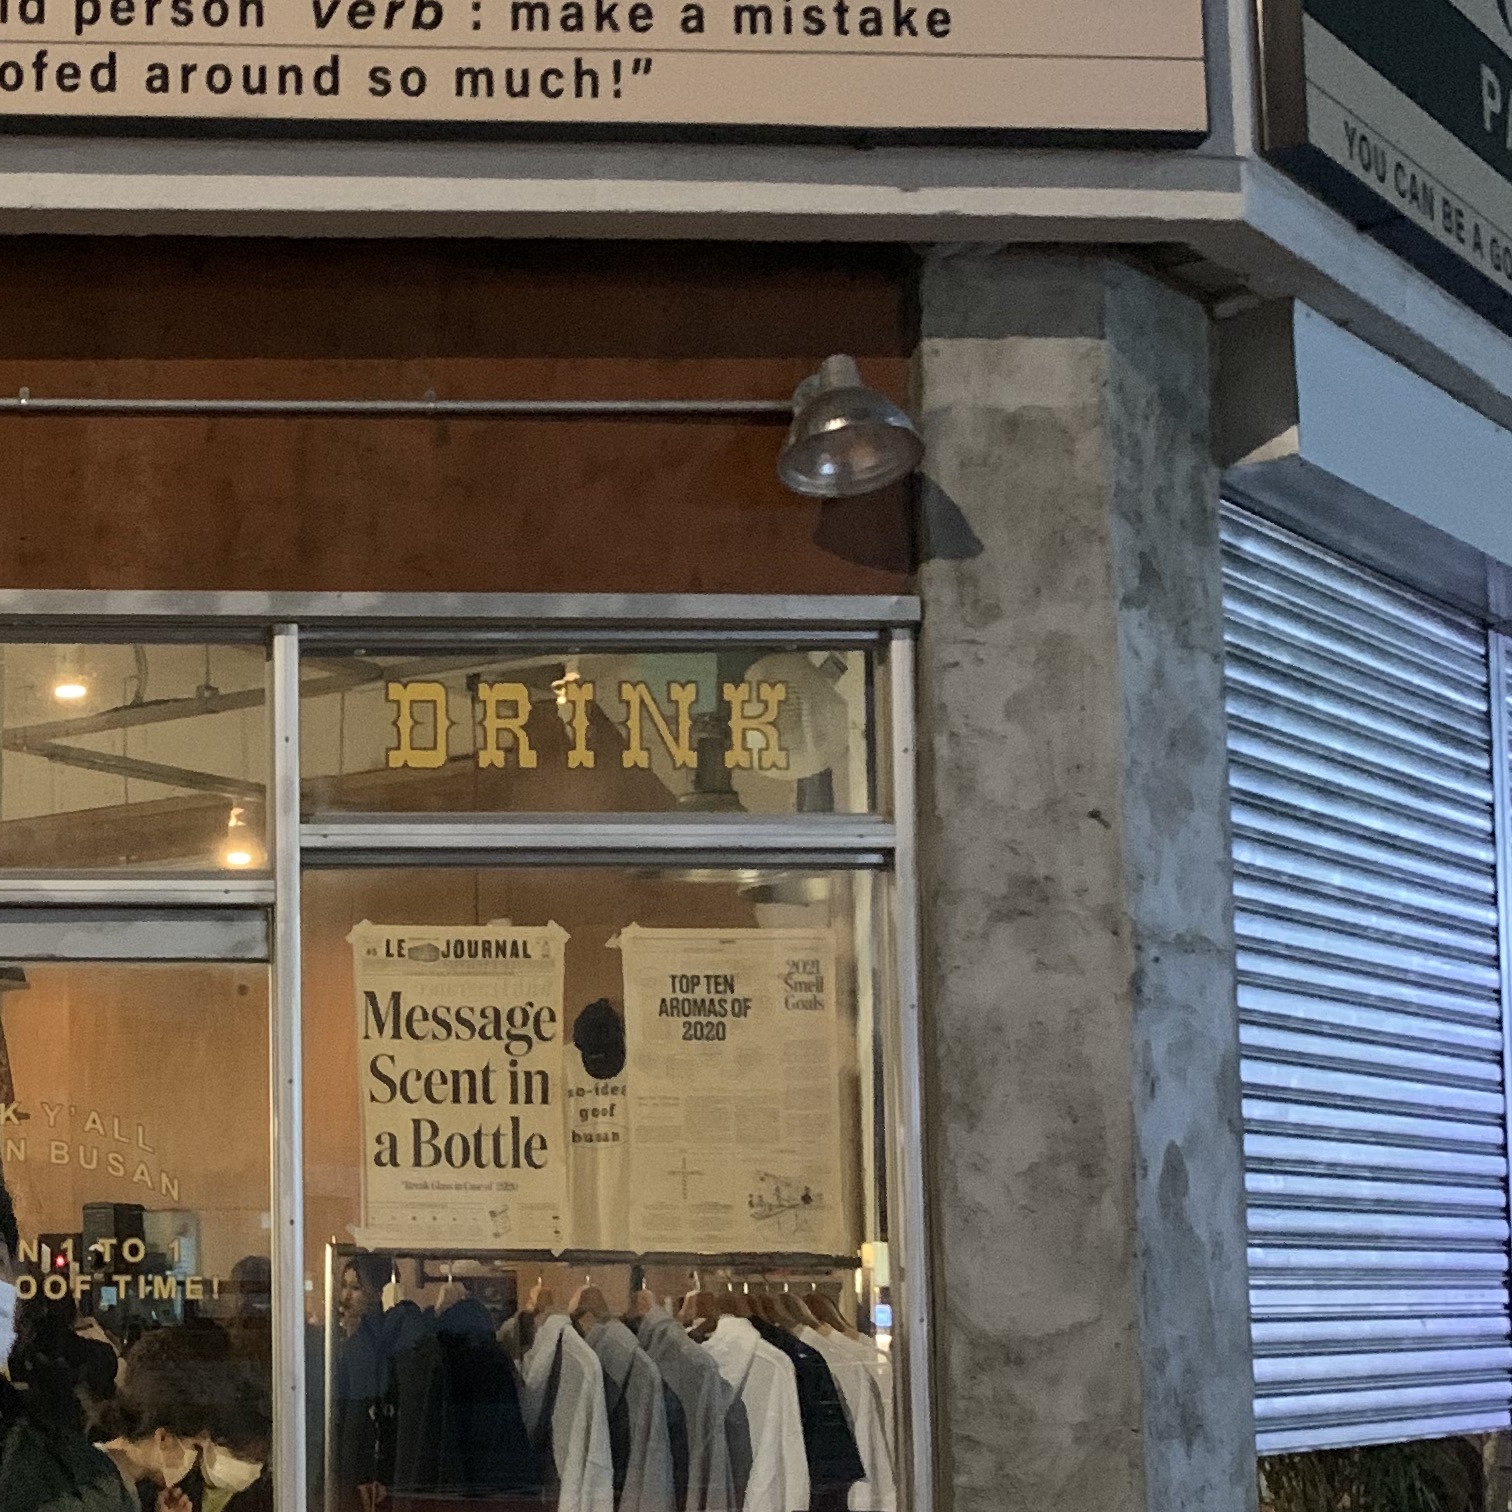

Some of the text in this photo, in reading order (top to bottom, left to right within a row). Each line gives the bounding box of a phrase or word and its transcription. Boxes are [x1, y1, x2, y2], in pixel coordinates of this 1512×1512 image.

[75, 0, 265, 35] person
[312, 0, 444, 32] verb
[510, 0, 655, 34] make
[679, 4, 706, 34] a
[733, 0, 952, 38] mistake
[145, 54, 341, 97] around
[368, 64, 427, 98] so
[1343, 119, 1387, 184] YOU
[1393, 161, 1436, 221] CAN
[1441, 196, 1466, 245] BE
[1471, 221, 1485, 260] A
[385, 680, 789, 770] DRINK
[385, 938, 407, 959] LE
[441, 938, 533, 960] JOURNAL
[669, 974, 735, 995] TOP TEN
[363, 989, 558, 1058] Message
[658, 997, 753, 1019] AROMAS OF
[681, 1020, 727, 1042] 2020
[369, 1053, 551, 1105] Scent in
[373, 1115, 550, 1170] a Bottle
[49, 1139, 180, 1202] BUSAN
[98, 1238, 147, 1263] TO
[16, 1274, 220, 1301] OOF TIME!
